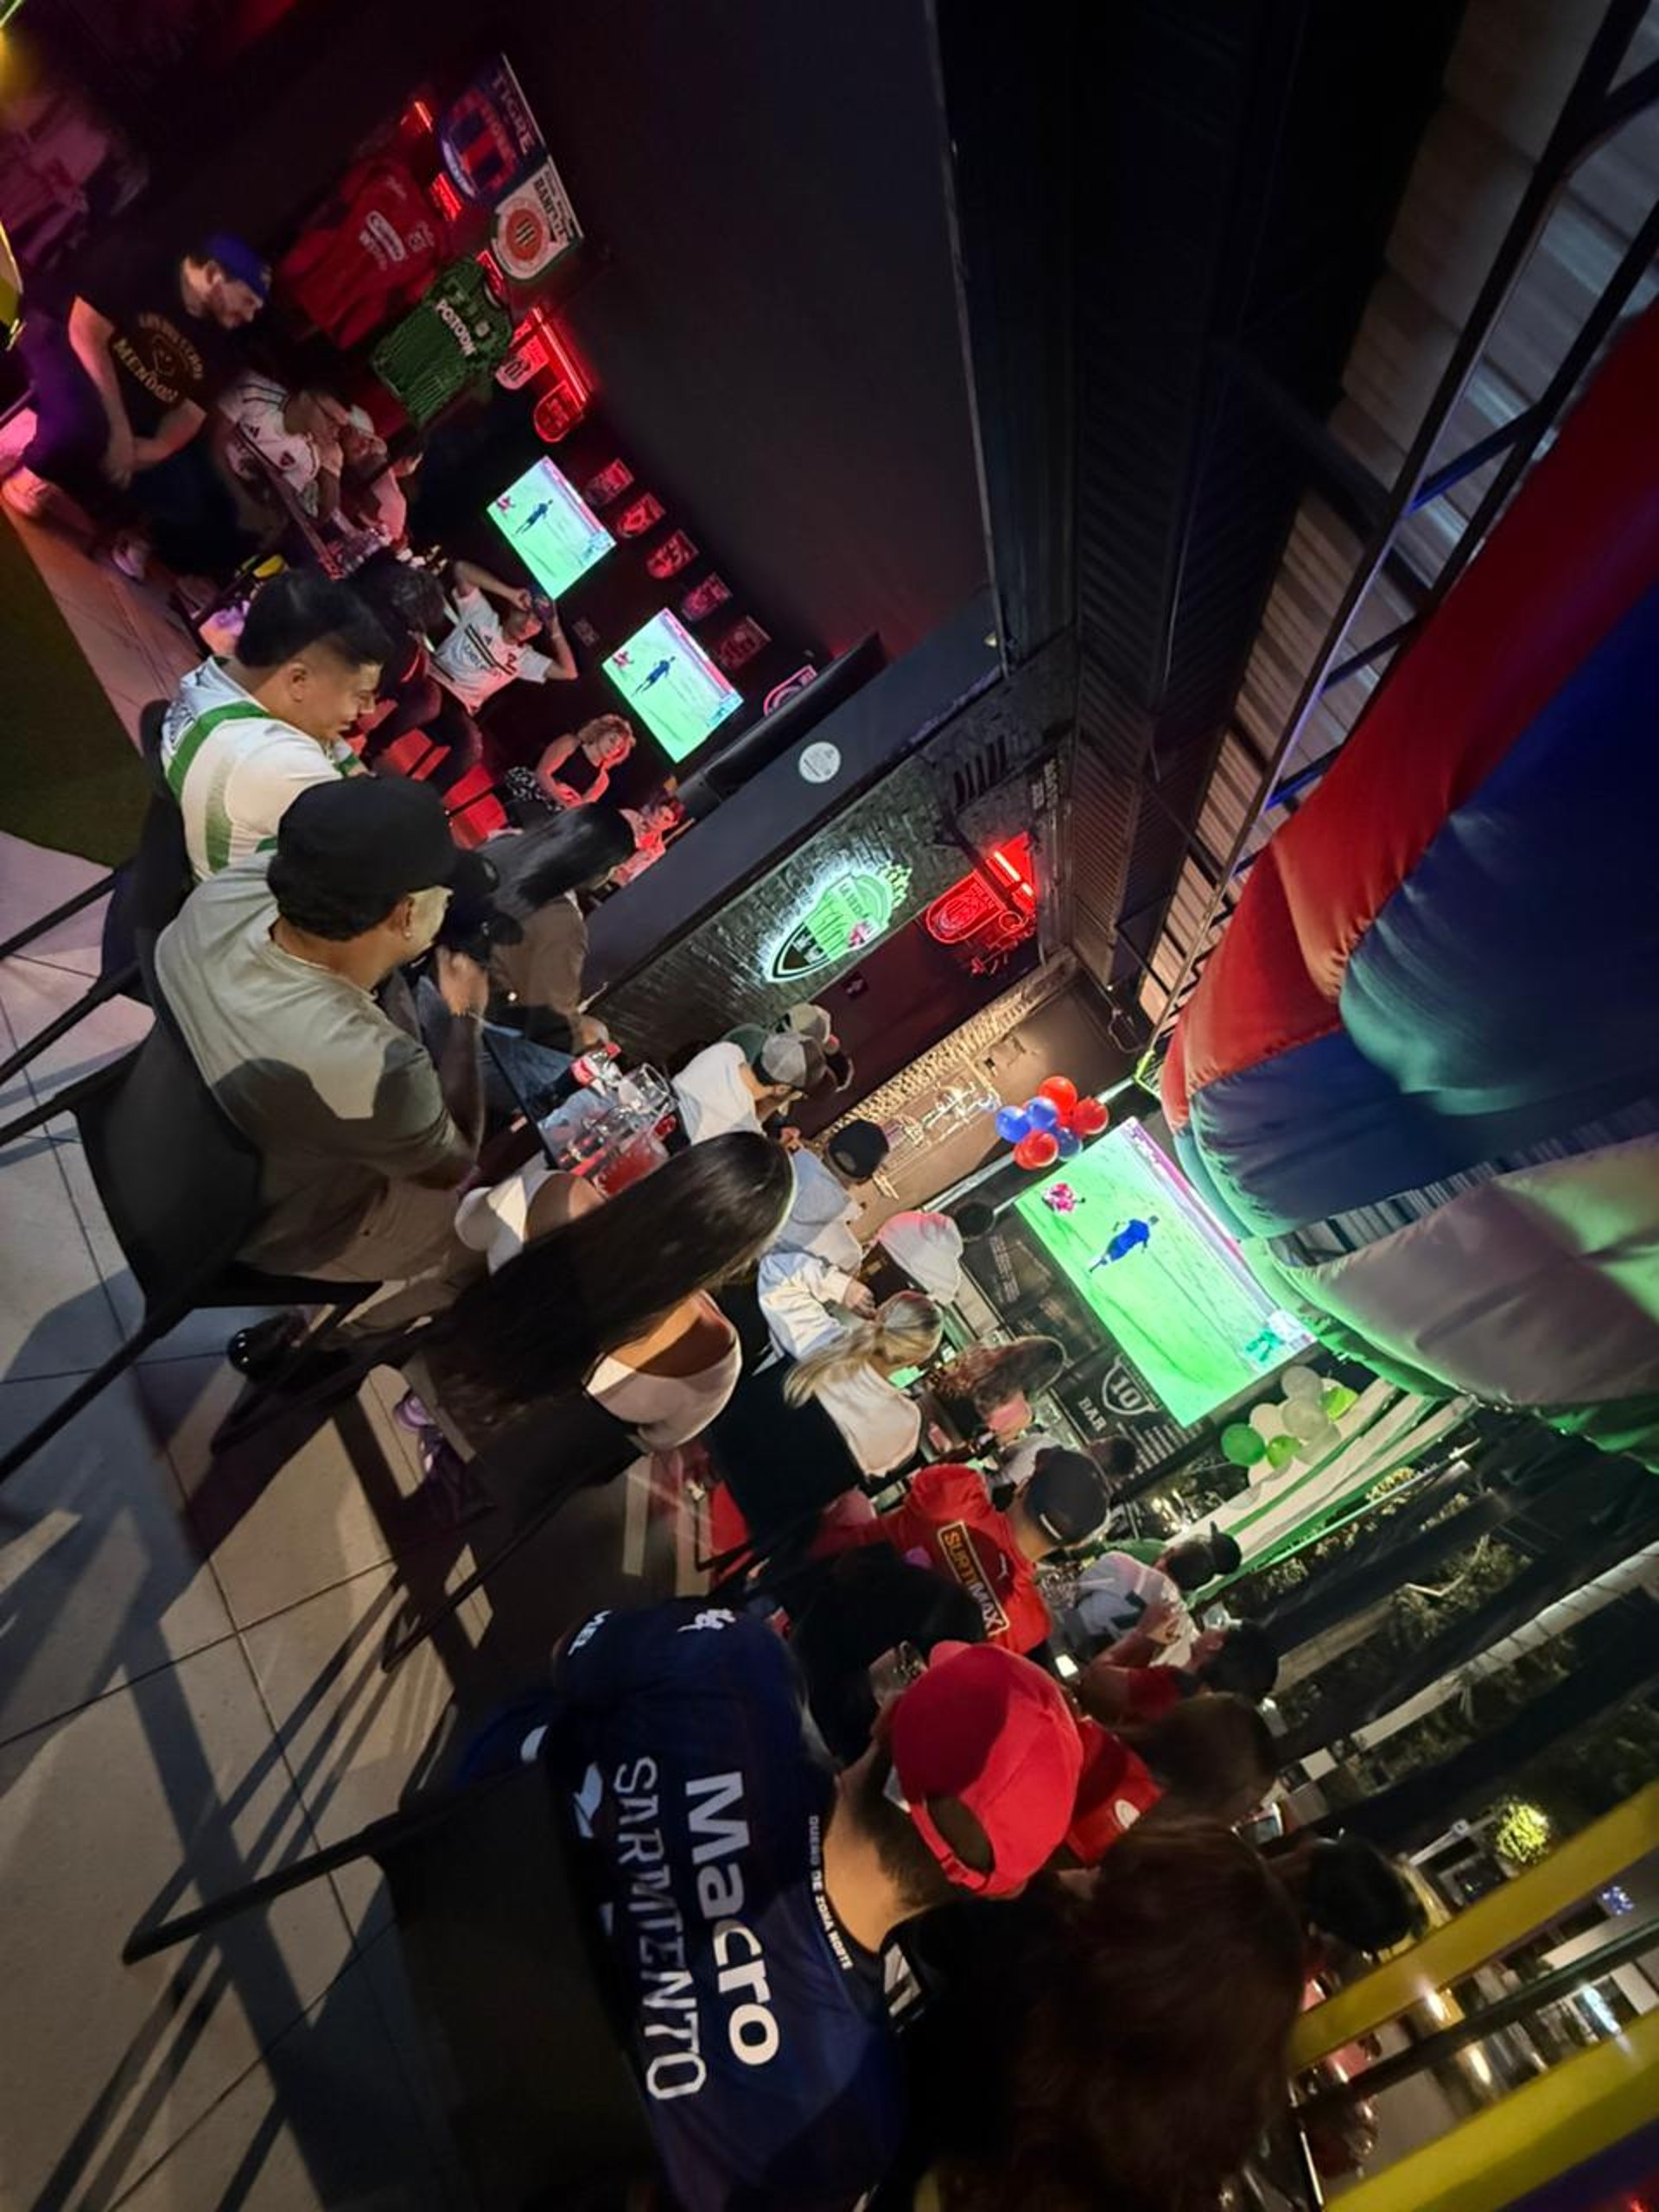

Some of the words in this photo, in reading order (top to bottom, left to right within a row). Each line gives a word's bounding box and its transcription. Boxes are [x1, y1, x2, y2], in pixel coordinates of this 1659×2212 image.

[493, 72, 535, 156] TIGRE
[533, 176, 570, 239] BANF
[1078, 1396, 1107, 1432] BAR
[1109, 1376, 1141, 1408] 10
[944, 1530, 1004, 1630] SURTIMAX
[810, 1870, 823, 1891] DE
[613, 1757, 707, 2101] SARMIENTO
[685, 1770, 779, 2066] Macro
[815, 1894, 836, 1932] ZONA
[828, 1930, 854, 1969] NORTE
